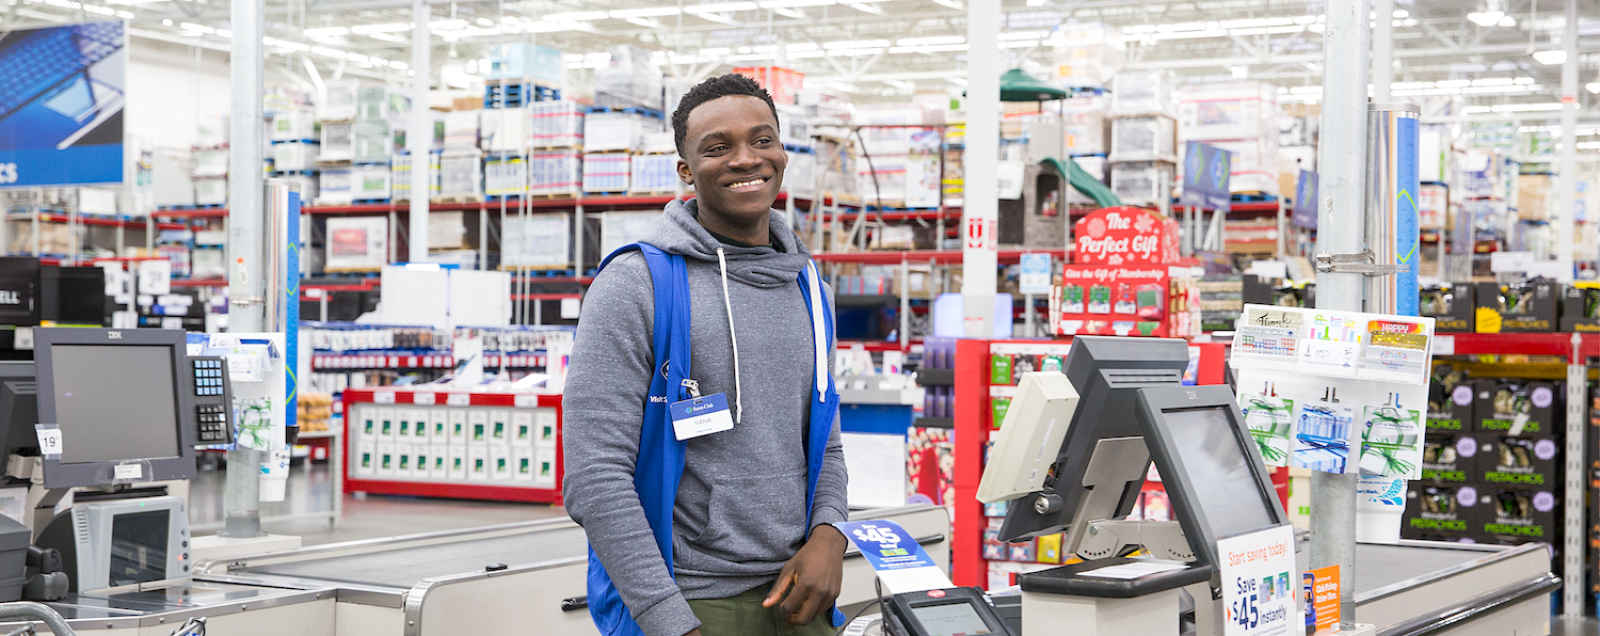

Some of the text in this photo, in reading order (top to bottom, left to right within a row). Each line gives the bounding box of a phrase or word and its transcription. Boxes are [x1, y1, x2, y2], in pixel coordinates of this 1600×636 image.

[1105, 212, 1131, 230] The
[1079, 234, 1158, 260] Perfect Gift
[1065, 268, 1164, 282] Give the Gift of Membership
[108, 331, 122, 339] IBM
[44, 436, 56, 447] 19
[1485, 471, 1545, 485] PISTACHIOS
[1410, 517, 1467, 531] PISTACHIOS
[1484, 523, 1544, 537] PISTACHIOS
[853, 527, 901, 544] $45
[1229, 539, 1288, 567] Start saving today!
[1237, 577, 1256, 595] Save
[1233, 594, 1259, 630] $45
[1260, 604, 1287, 625] instantly
